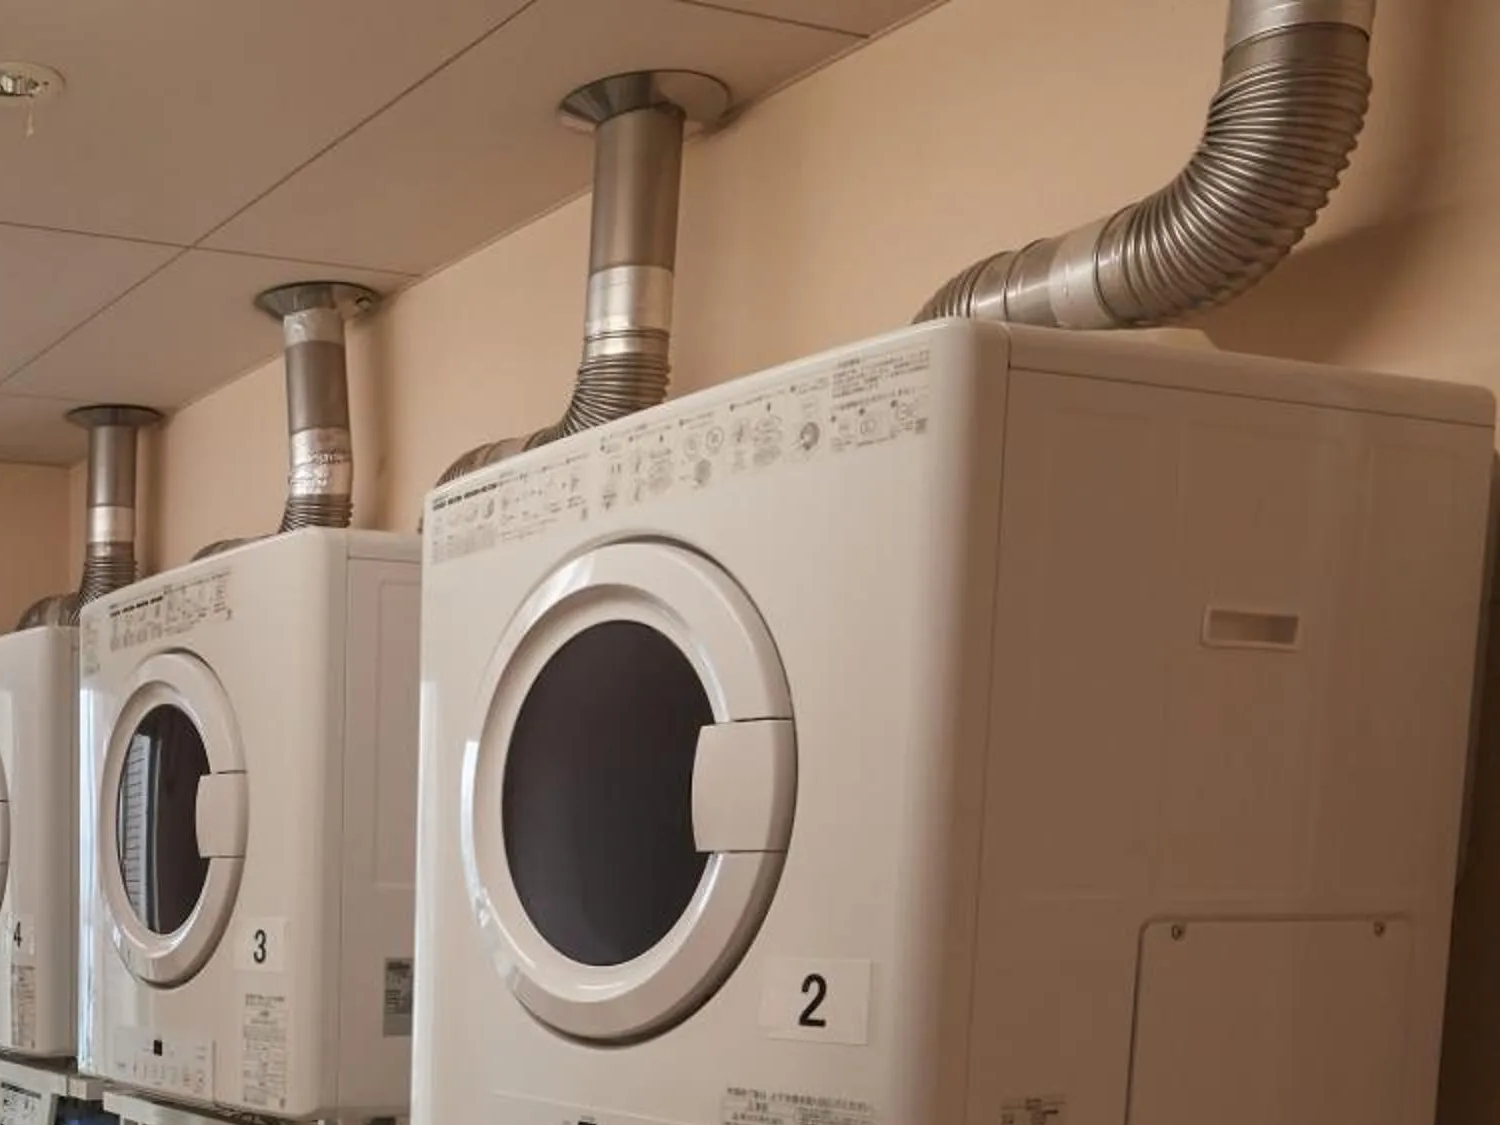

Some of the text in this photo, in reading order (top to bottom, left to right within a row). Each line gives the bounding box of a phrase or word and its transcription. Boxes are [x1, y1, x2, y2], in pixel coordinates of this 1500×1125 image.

[13, 920, 23, 948] 4
[253, 929, 267, 964] 3
[799, 973, 827, 1027] 2
